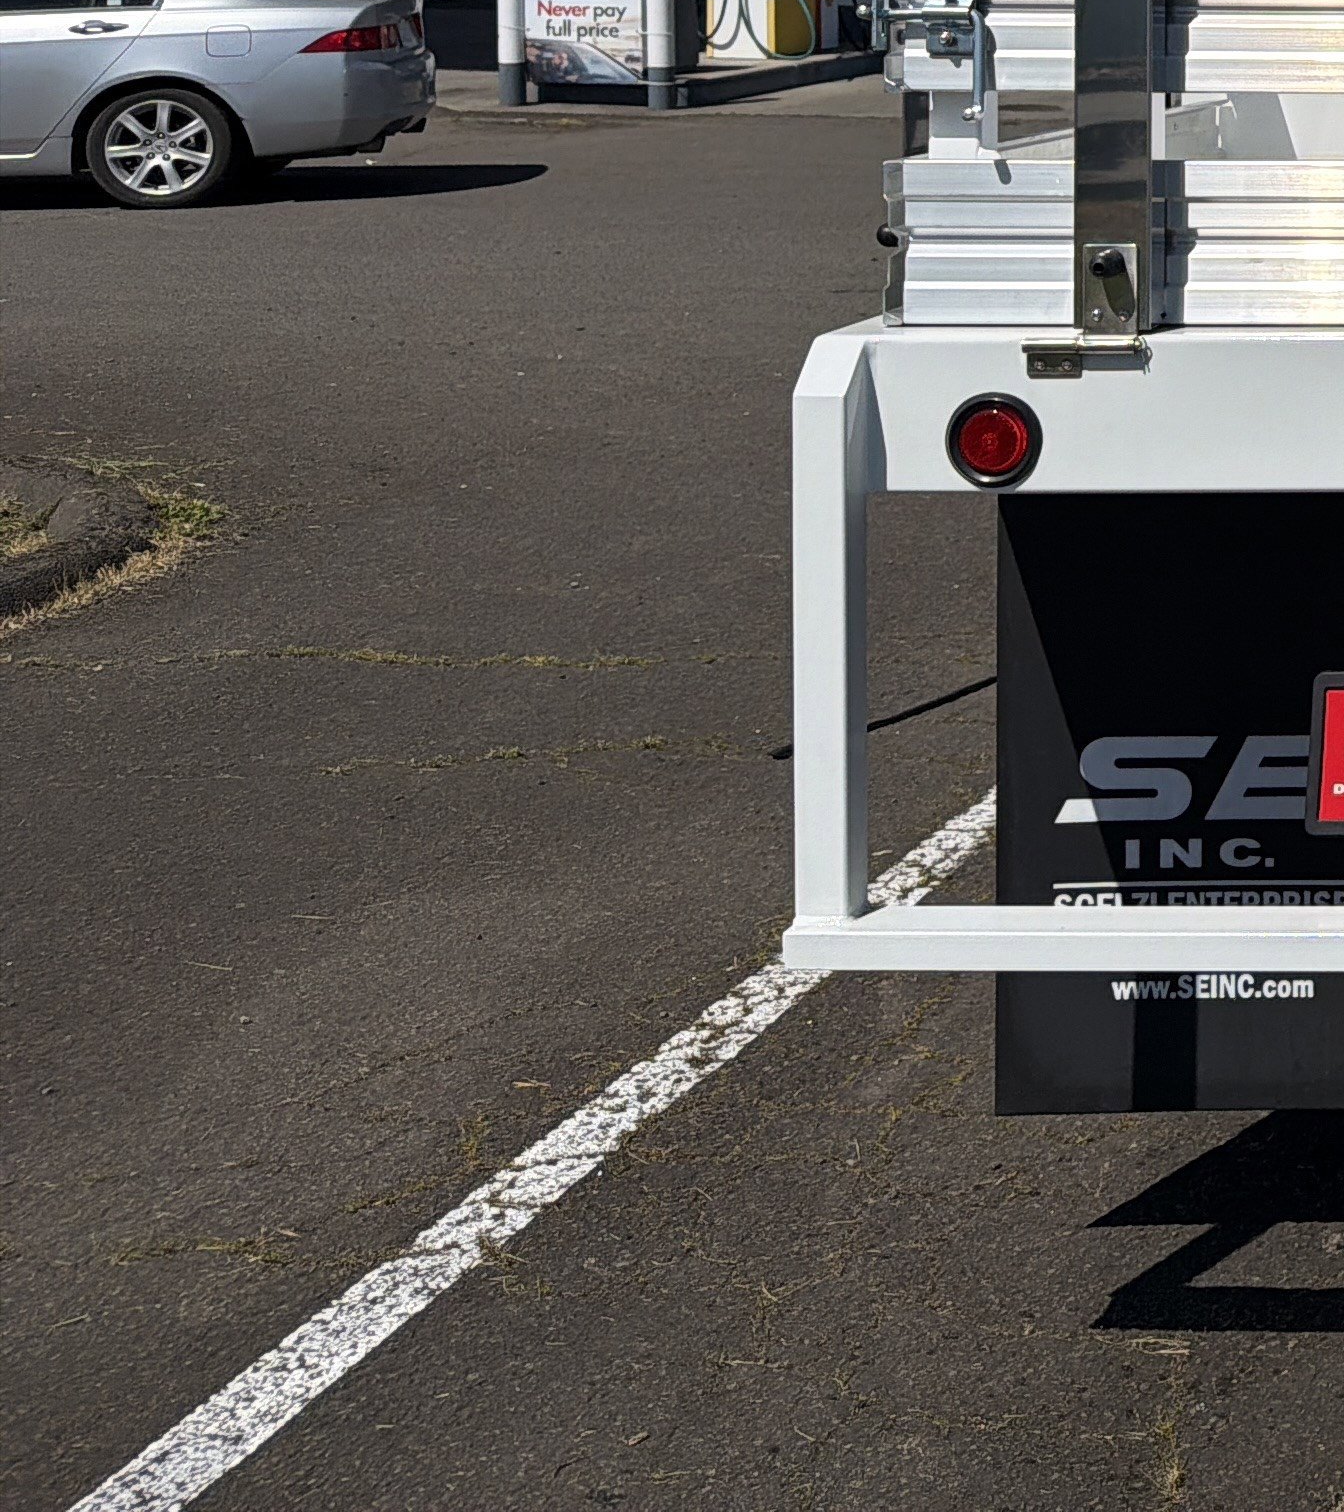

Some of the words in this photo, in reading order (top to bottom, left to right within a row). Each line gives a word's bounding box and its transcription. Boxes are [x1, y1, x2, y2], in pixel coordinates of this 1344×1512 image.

[536, 0, 591, 17] Never
[592, 5, 628, 24] pay
[545, 18, 572, 37] full
[576, 23, 620, 43] price
[1054, 735, 1310, 824] SE
[1124, 838, 1276, 870] INC.
[1111, 974, 1315, 1001] www.SEINC.com
